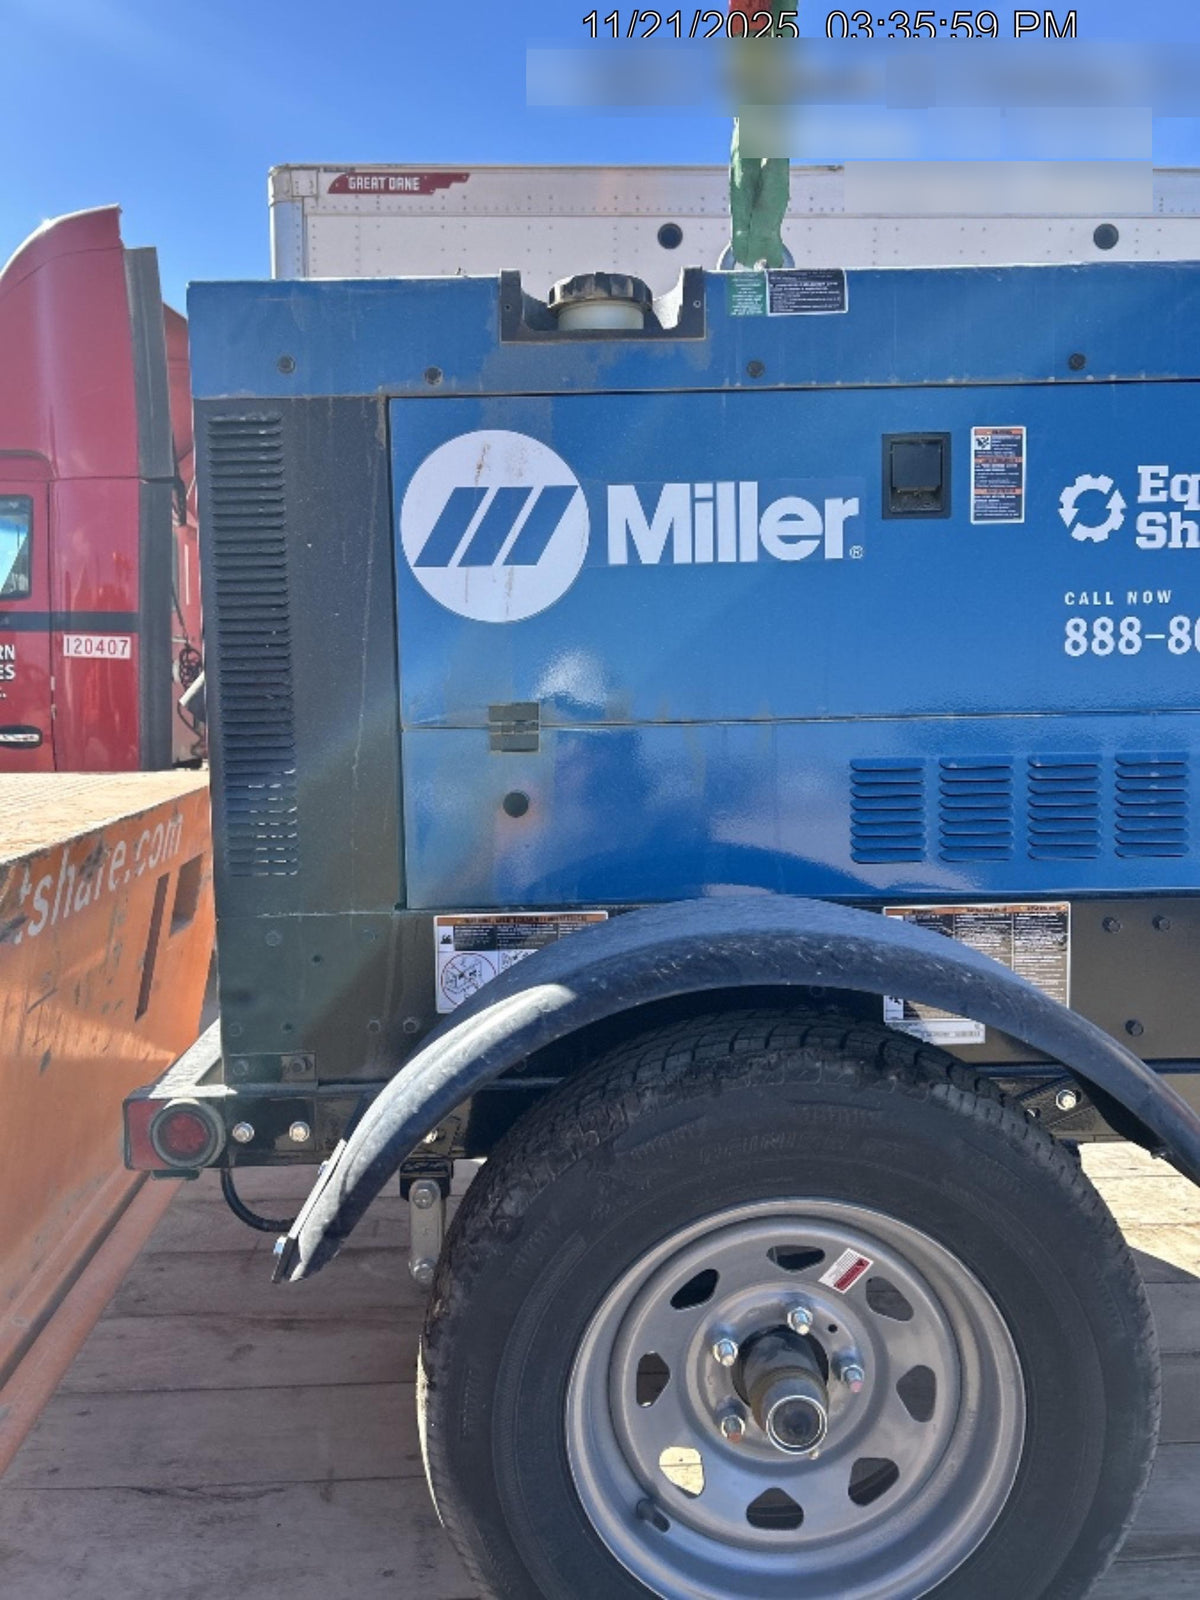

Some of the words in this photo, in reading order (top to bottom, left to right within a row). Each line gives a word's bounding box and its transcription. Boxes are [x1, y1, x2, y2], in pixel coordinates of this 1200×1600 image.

[347, 176, 386, 190] GREAT
[388, 177, 421, 191] DANE
[1135, 511, 1200, 550] Sh
[1064, 591, 1115, 606] CALL
[1126, 589, 1172, 605] NOW
[1064, 614, 1200, 657] 888-8
[65, 637, 129, 656] 120407
